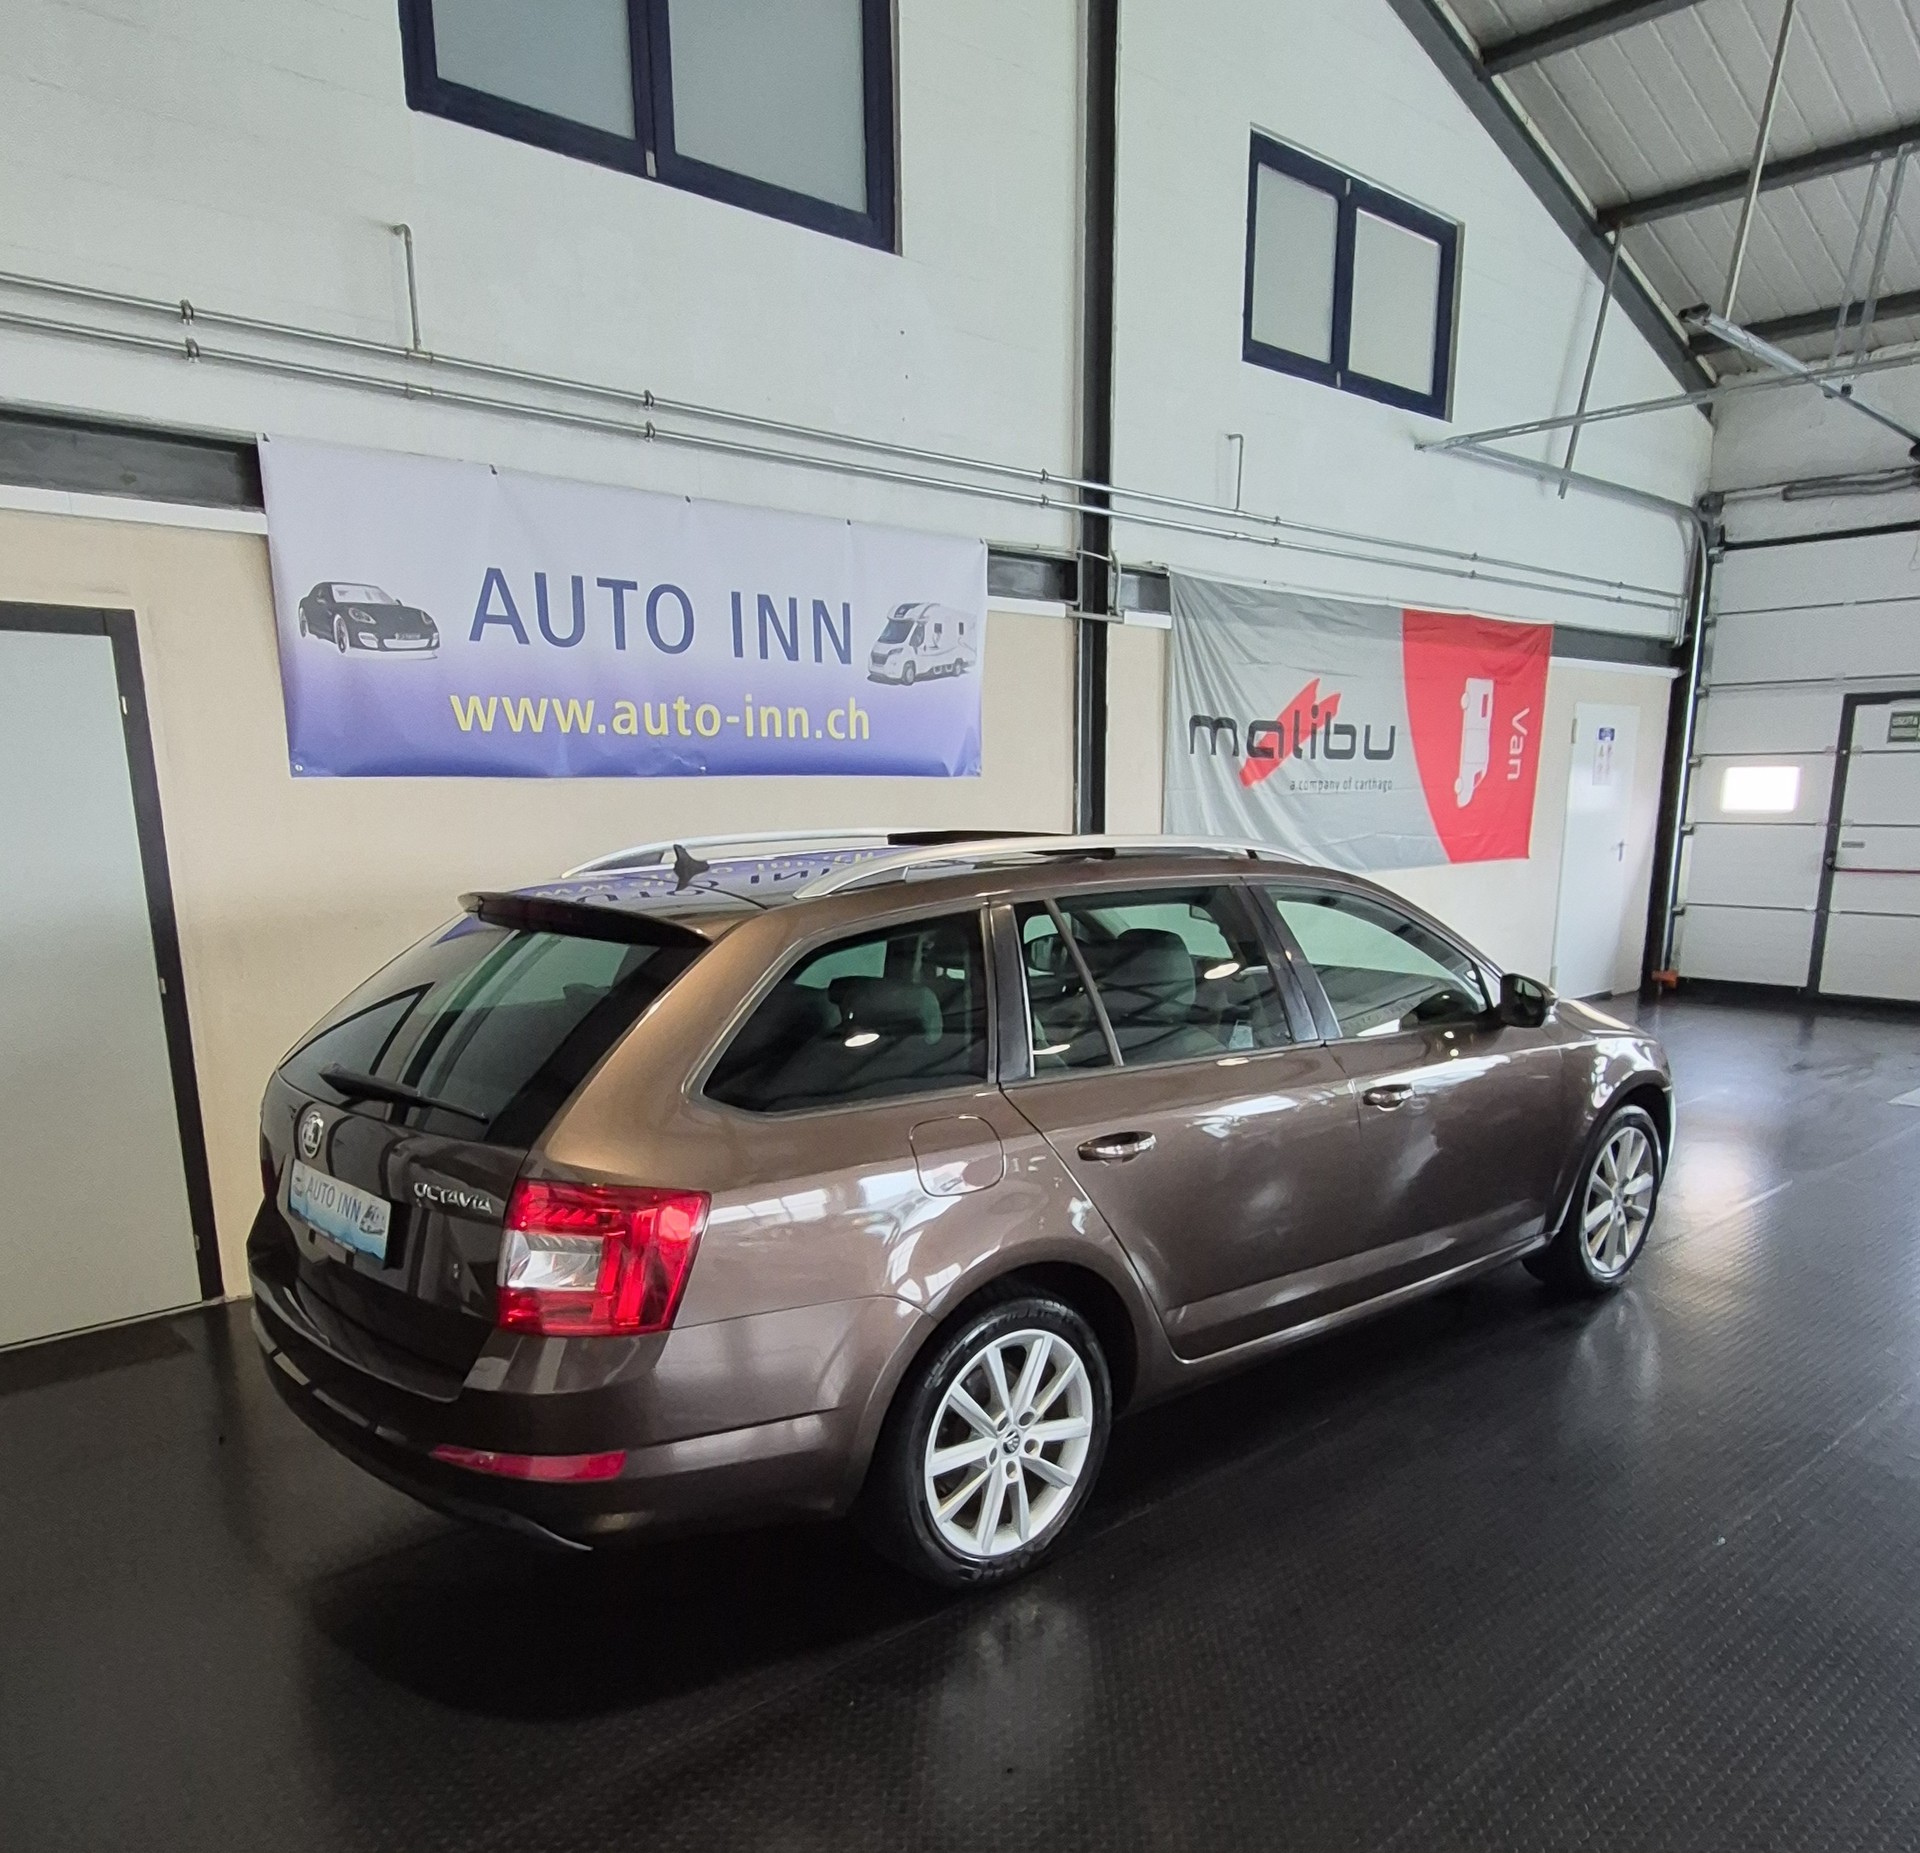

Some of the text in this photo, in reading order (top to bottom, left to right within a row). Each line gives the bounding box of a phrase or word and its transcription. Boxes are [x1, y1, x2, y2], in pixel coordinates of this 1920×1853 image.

[469, 567, 853, 665] AUTO INN
[450, 694, 871, 741] www.auto-inn.ch
[1189, 704, 1396, 761] malibu
[1507, 707, 1531, 781] Van
[1299, 780, 1339, 793] company
[1343, 776, 1352, 791] of
[1355, 779, 1393, 793] carthago
[305, 1176, 362, 1222] AUTO INN
[413, 1182, 492, 1214] OCTAVIA
